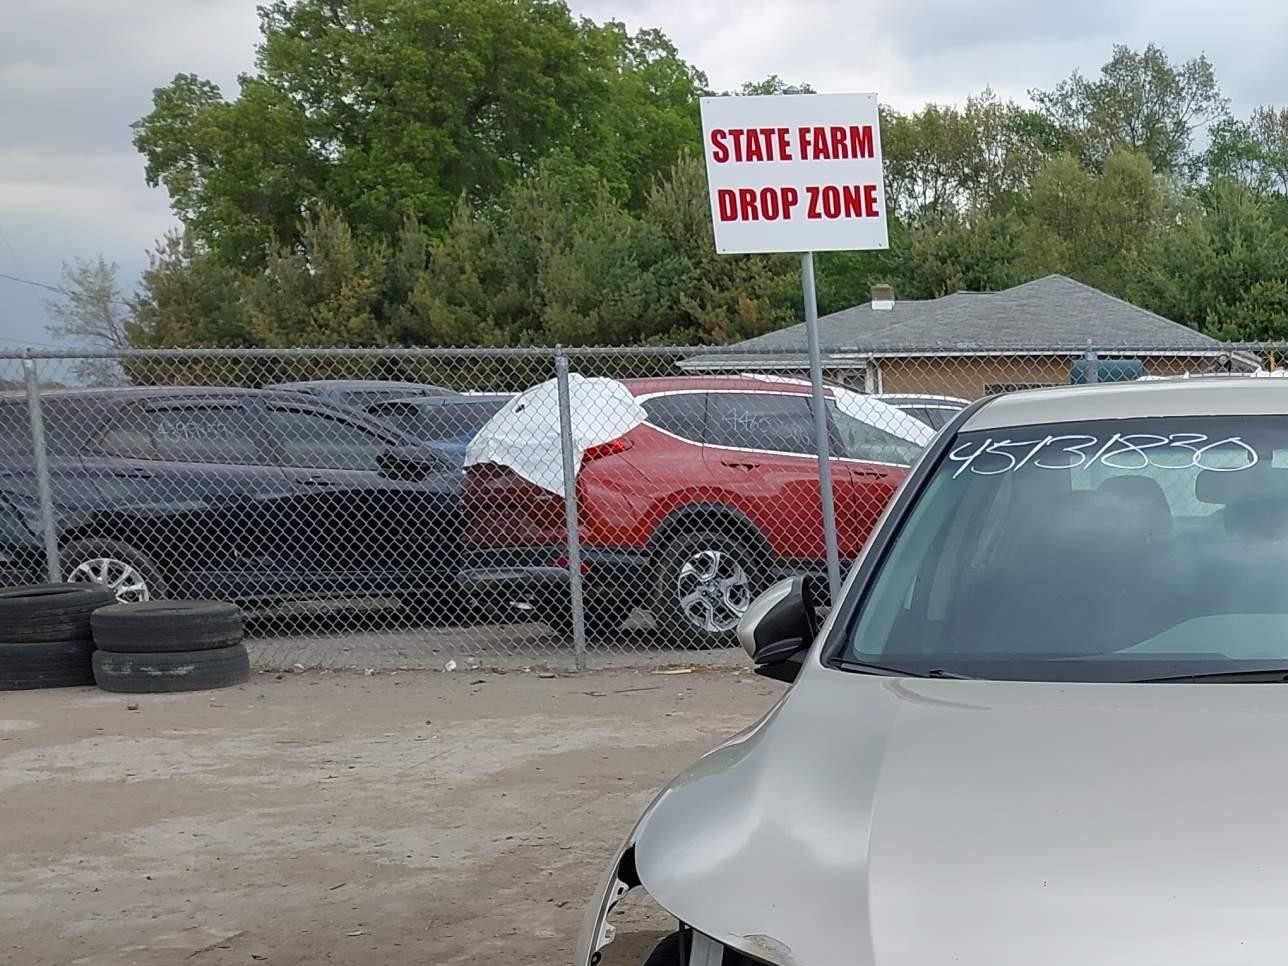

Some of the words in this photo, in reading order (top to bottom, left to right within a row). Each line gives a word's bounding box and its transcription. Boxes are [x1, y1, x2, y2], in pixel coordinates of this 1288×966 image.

[710, 127, 793, 163] STATE
[798, 125, 875, 161] FARM
[717, 186, 799, 222] DROP
[805, 184, 880, 220] ZONE
[949, 433, 1258, 479] 45131830
